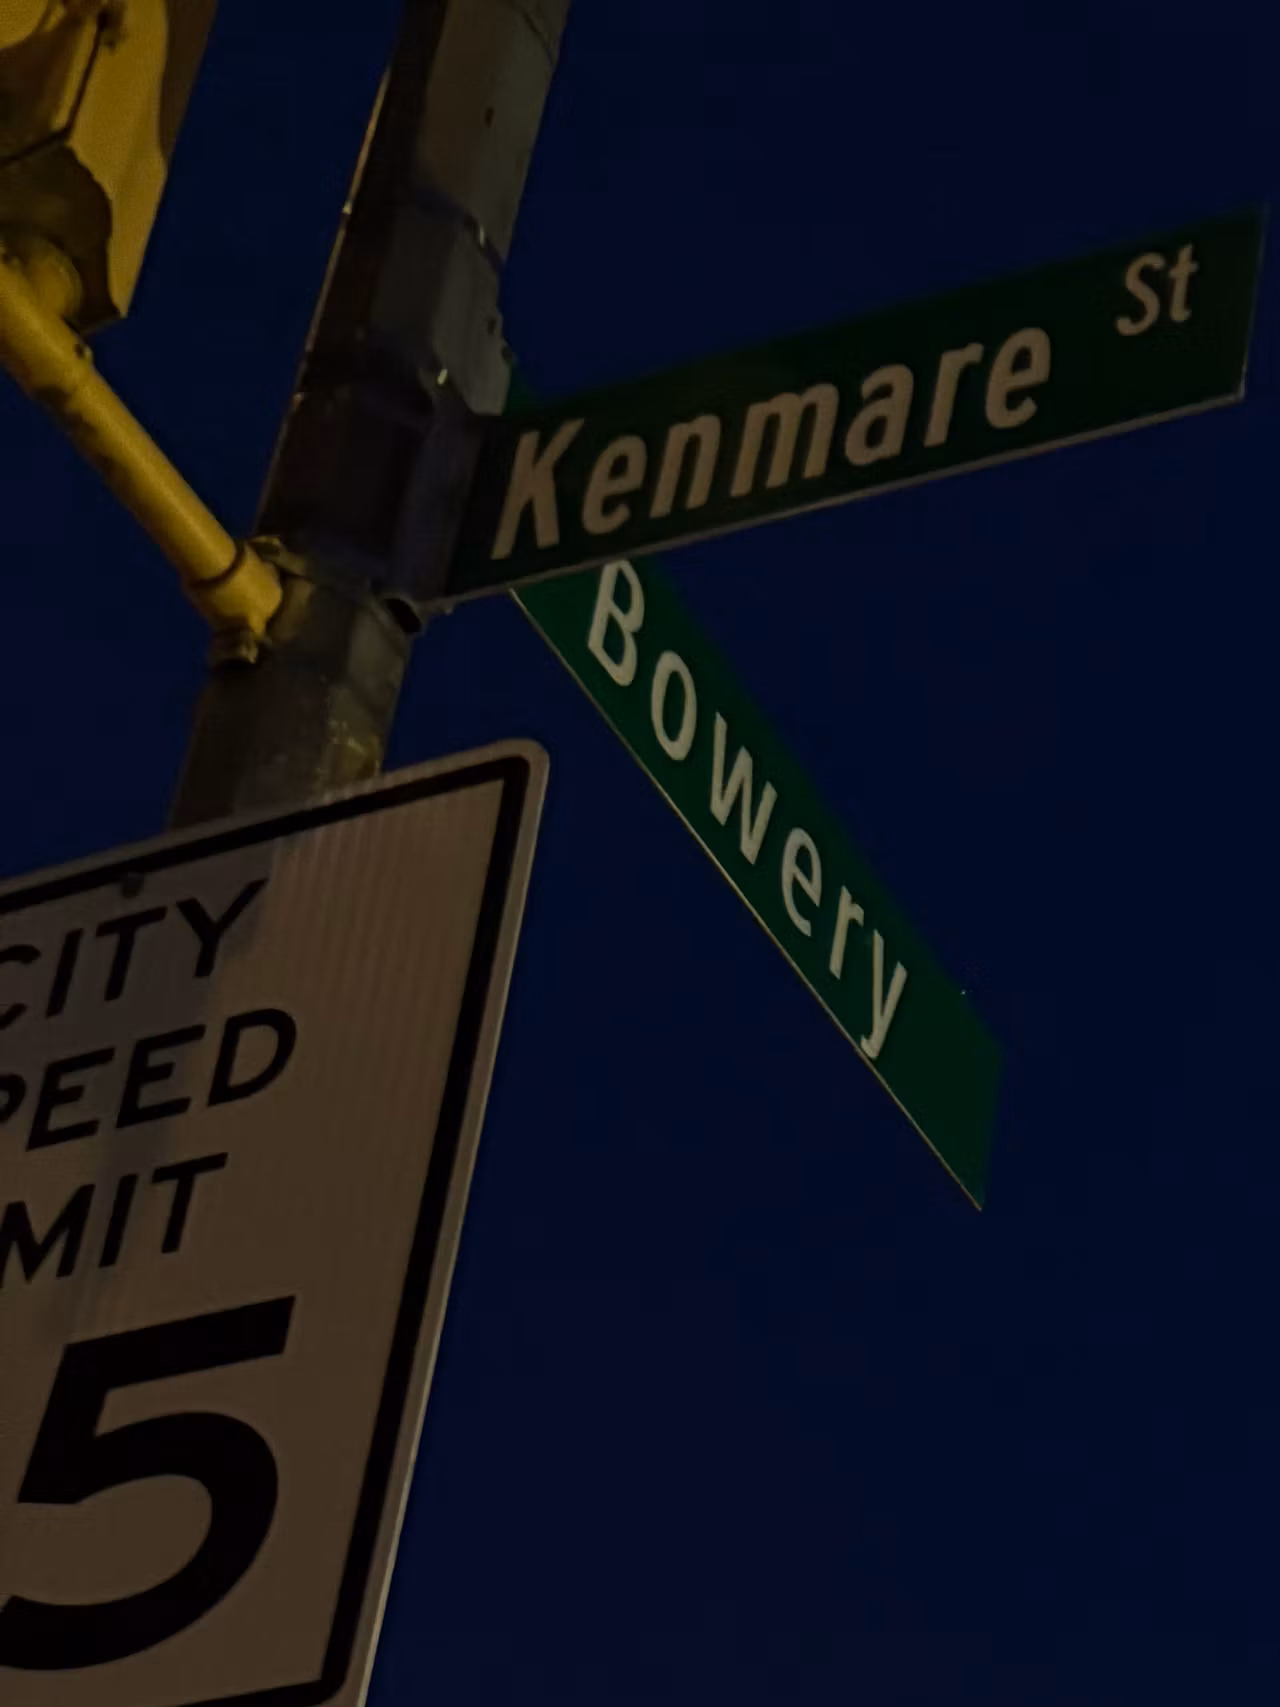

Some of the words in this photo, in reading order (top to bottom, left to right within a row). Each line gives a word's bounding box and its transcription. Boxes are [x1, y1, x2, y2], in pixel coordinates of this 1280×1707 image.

[492, 325, 1052, 559] Kenmare
[1115, 242, 1199, 336] St
[585, 557, 909, 1061] Bowery
